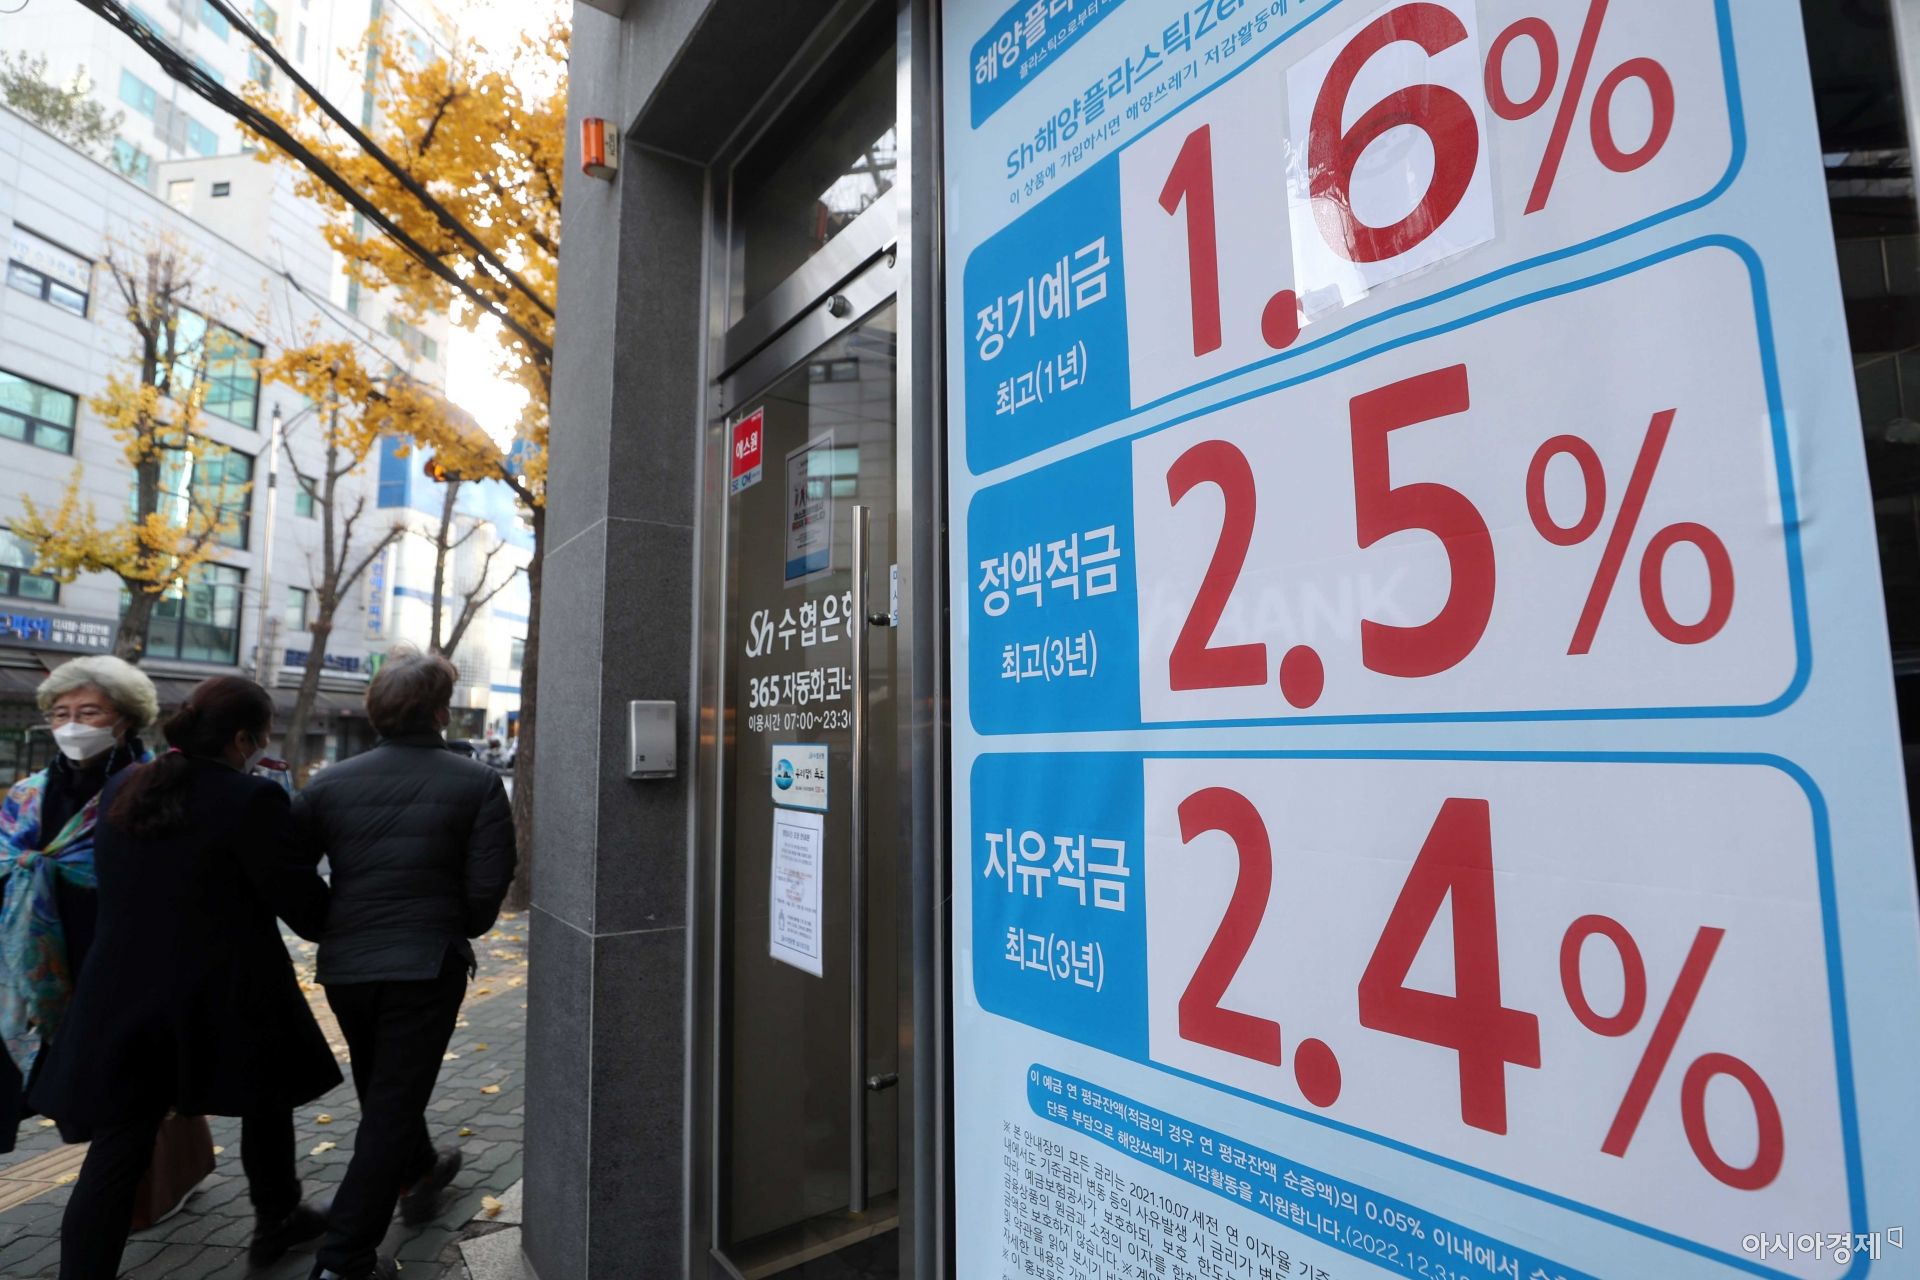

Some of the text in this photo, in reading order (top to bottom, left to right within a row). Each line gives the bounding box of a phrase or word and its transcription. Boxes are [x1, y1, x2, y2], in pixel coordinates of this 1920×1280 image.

[1009, 0, 1288, 204] 이 상품에 가입하시면 해양쓰레기 저감활동에
[1157, 0, 1676, 358] 1.6%
[975, 235, 1111, 362] 정기예금
[995, 340, 1088, 416] 최고(1년)
[735, 430, 759, 460] 에스원
[978, 524, 1121, 618] 정액적금
[1165, 362, 1736, 710] 2.5%
[745, 609, 775, 659] Sh
[1001, 629, 1098, 684] 최고(3년)
[748, 709, 852, 733] 이용시간 07:00~23:3
[749, 674, 780, 709] 365
[983, 828, 1131, 912] 자유적금
[1005, 926, 1105, 993] 최고(3년)
[1176, 785, 1786, 1192] 2.4%
[1030, 1070, 1520, 1280] 이 예금 연 평균잔액(적금의 경우 연 평균잔액 순증액)의 0.05% 이내에서
[1046, 1100, 1069, 1121] 단독
[1071, 1109, 1115, 1142] 부담으로
[1117, 1130, 1178, 1171] 해양쓰레기
[1183, 1158, 1253, 1203] 저감활동을
[1003, 1136, 1037, 1167] 내에서도
[1040, 1157, 1083, 1190] 기준금리
[1086, 1177, 1106, 1202] 변동
[1109, 1191, 1131, 1217] 등의
[1135, 1205, 1187, 1243] 사유발생
[1192, 1232, 1205, 1253] 시
[1209, 1239, 1254, 1277] 금리가
[1003, 1154, 1020, 1177] 따라
[1024, 1168, 1097, 1217] 예금보험공사가
[1103, 1208, 1154, 1249] 보호하되,
[1162, 1238, 1189, 1264] 보호
[1003, 1172, 1050, 1211] 금융상품의
[1055, 1200, 1087, 1230] 원금과
[1089, 1221, 1122, 1254] 소정의
[1127, 1242, 1167, 1276] 이자를
[1003, 1191, 1029, 1219] 금액은
[1030, 1208, 1073, 1242] 보호하지
[1075, 1230, 1120, 1271] 않습니다.
[1013, 1216, 1044, 1244] 약관을
[1048, 1233, 1068, 1259] 읽어
[1072, 1249, 1101, 1280] 보시기
[1024, 1130, 1064, 1162] 안내장의
[1068, 1151, 1090, 1173] 모든
[1093, 1162, 1126, 1192] 금리는
[1225, 1225, 1239, 1247] 연
[1245, 1235, 1292, 1274] 이자율
[1003, 1226, 1030, 1256] 자세한
[1033, 1246, 1065, 1275] 내용은
